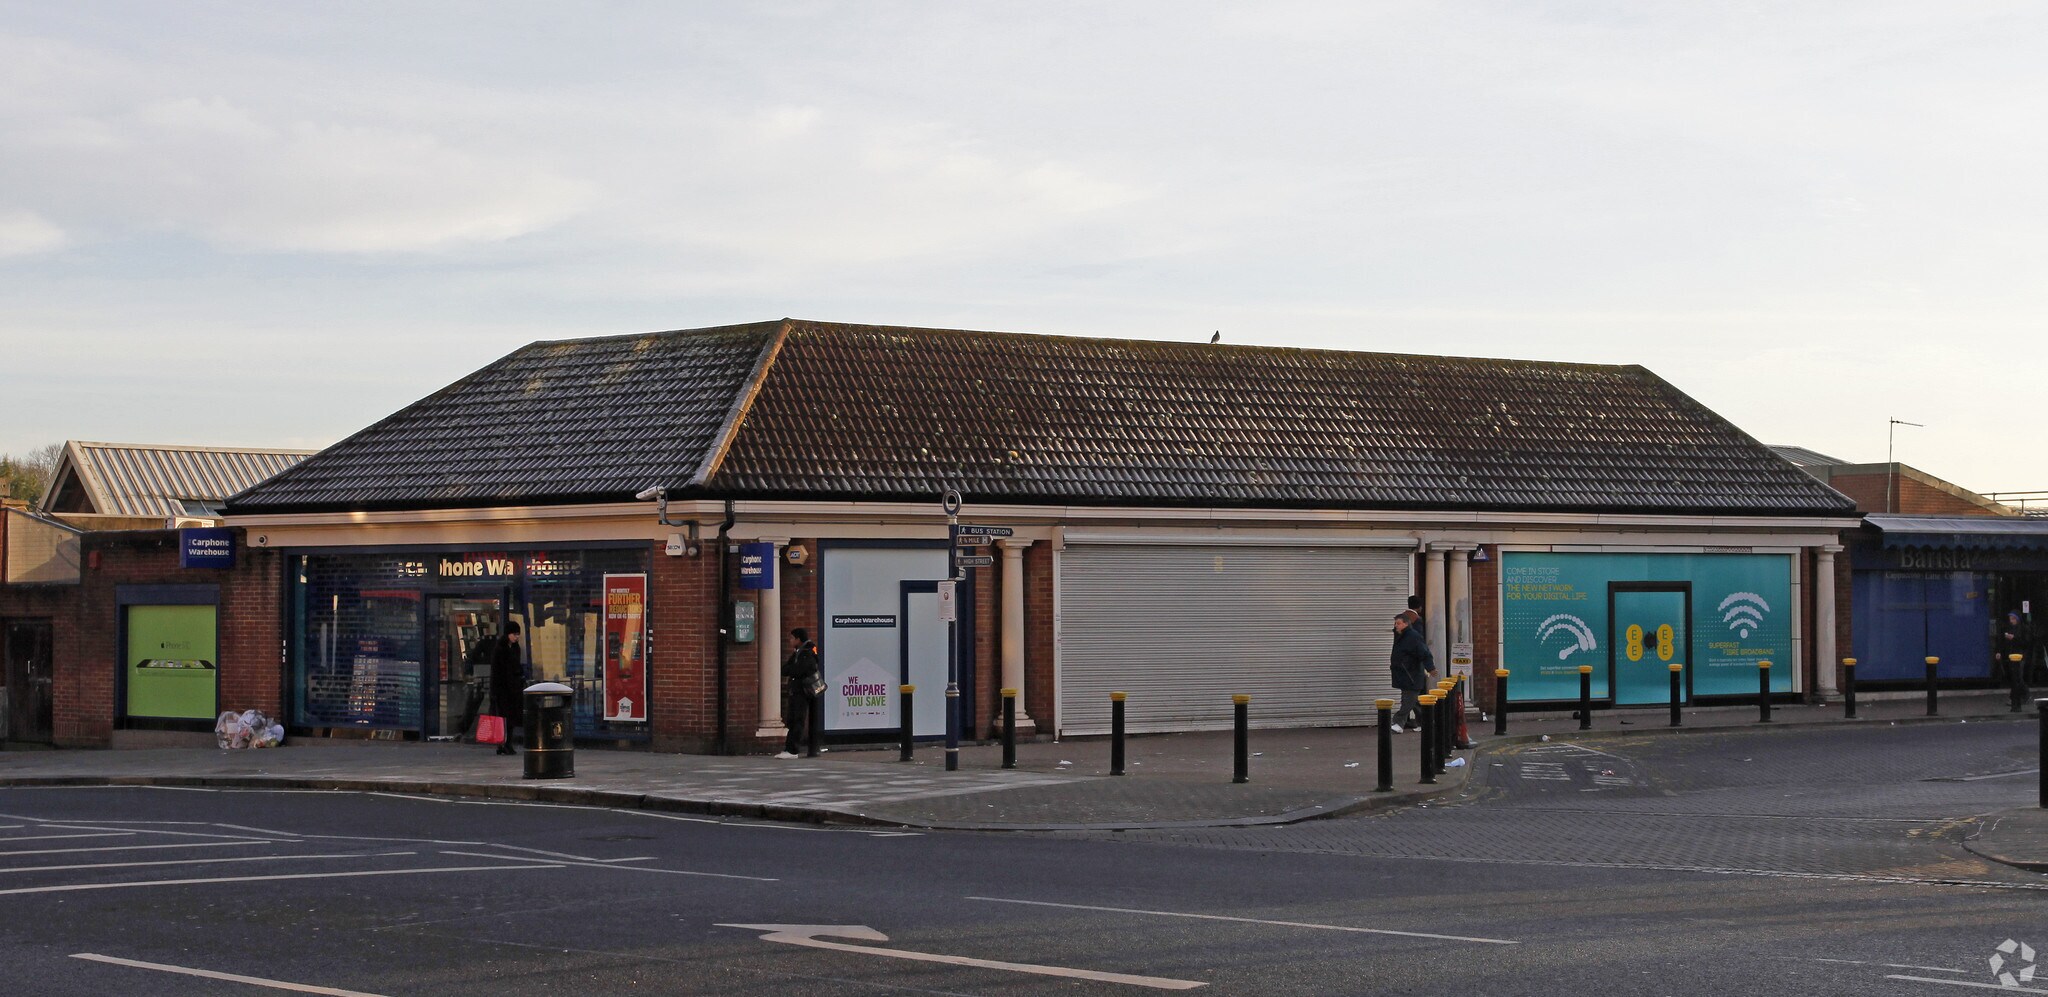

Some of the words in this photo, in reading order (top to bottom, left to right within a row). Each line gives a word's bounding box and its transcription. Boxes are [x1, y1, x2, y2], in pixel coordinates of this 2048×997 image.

[191, 538, 230, 547] Carphone
[188, 548, 230, 556] Warehouse
[742, 555, 762, 565] Carphone
[1900, 550, 1971, 569] Barista
[1506, 567, 1527, 575] COME
[1528, 567, 1536, 575] IN
[1537, 567, 1560, 575] STORE
[608, 593, 641, 605] FURTHER
[1506, 592, 1521, 600] FOR
[1522, 592, 1542, 600] YOUR
[1543, 592, 1571, 600] DIGITAL
[1571, 592, 1588, 600] LIFE
[834, 617, 862, 625] Carphone
[1722, 648, 1739, 656] FIBRE
[1740, 648, 1774, 656] BROADBAND
[848, 676, 859, 684] WE
[842, 684, 886, 697] COMPARE
[847, 696, 863, 707] YOU
[865, 696, 886, 707] SAVE
